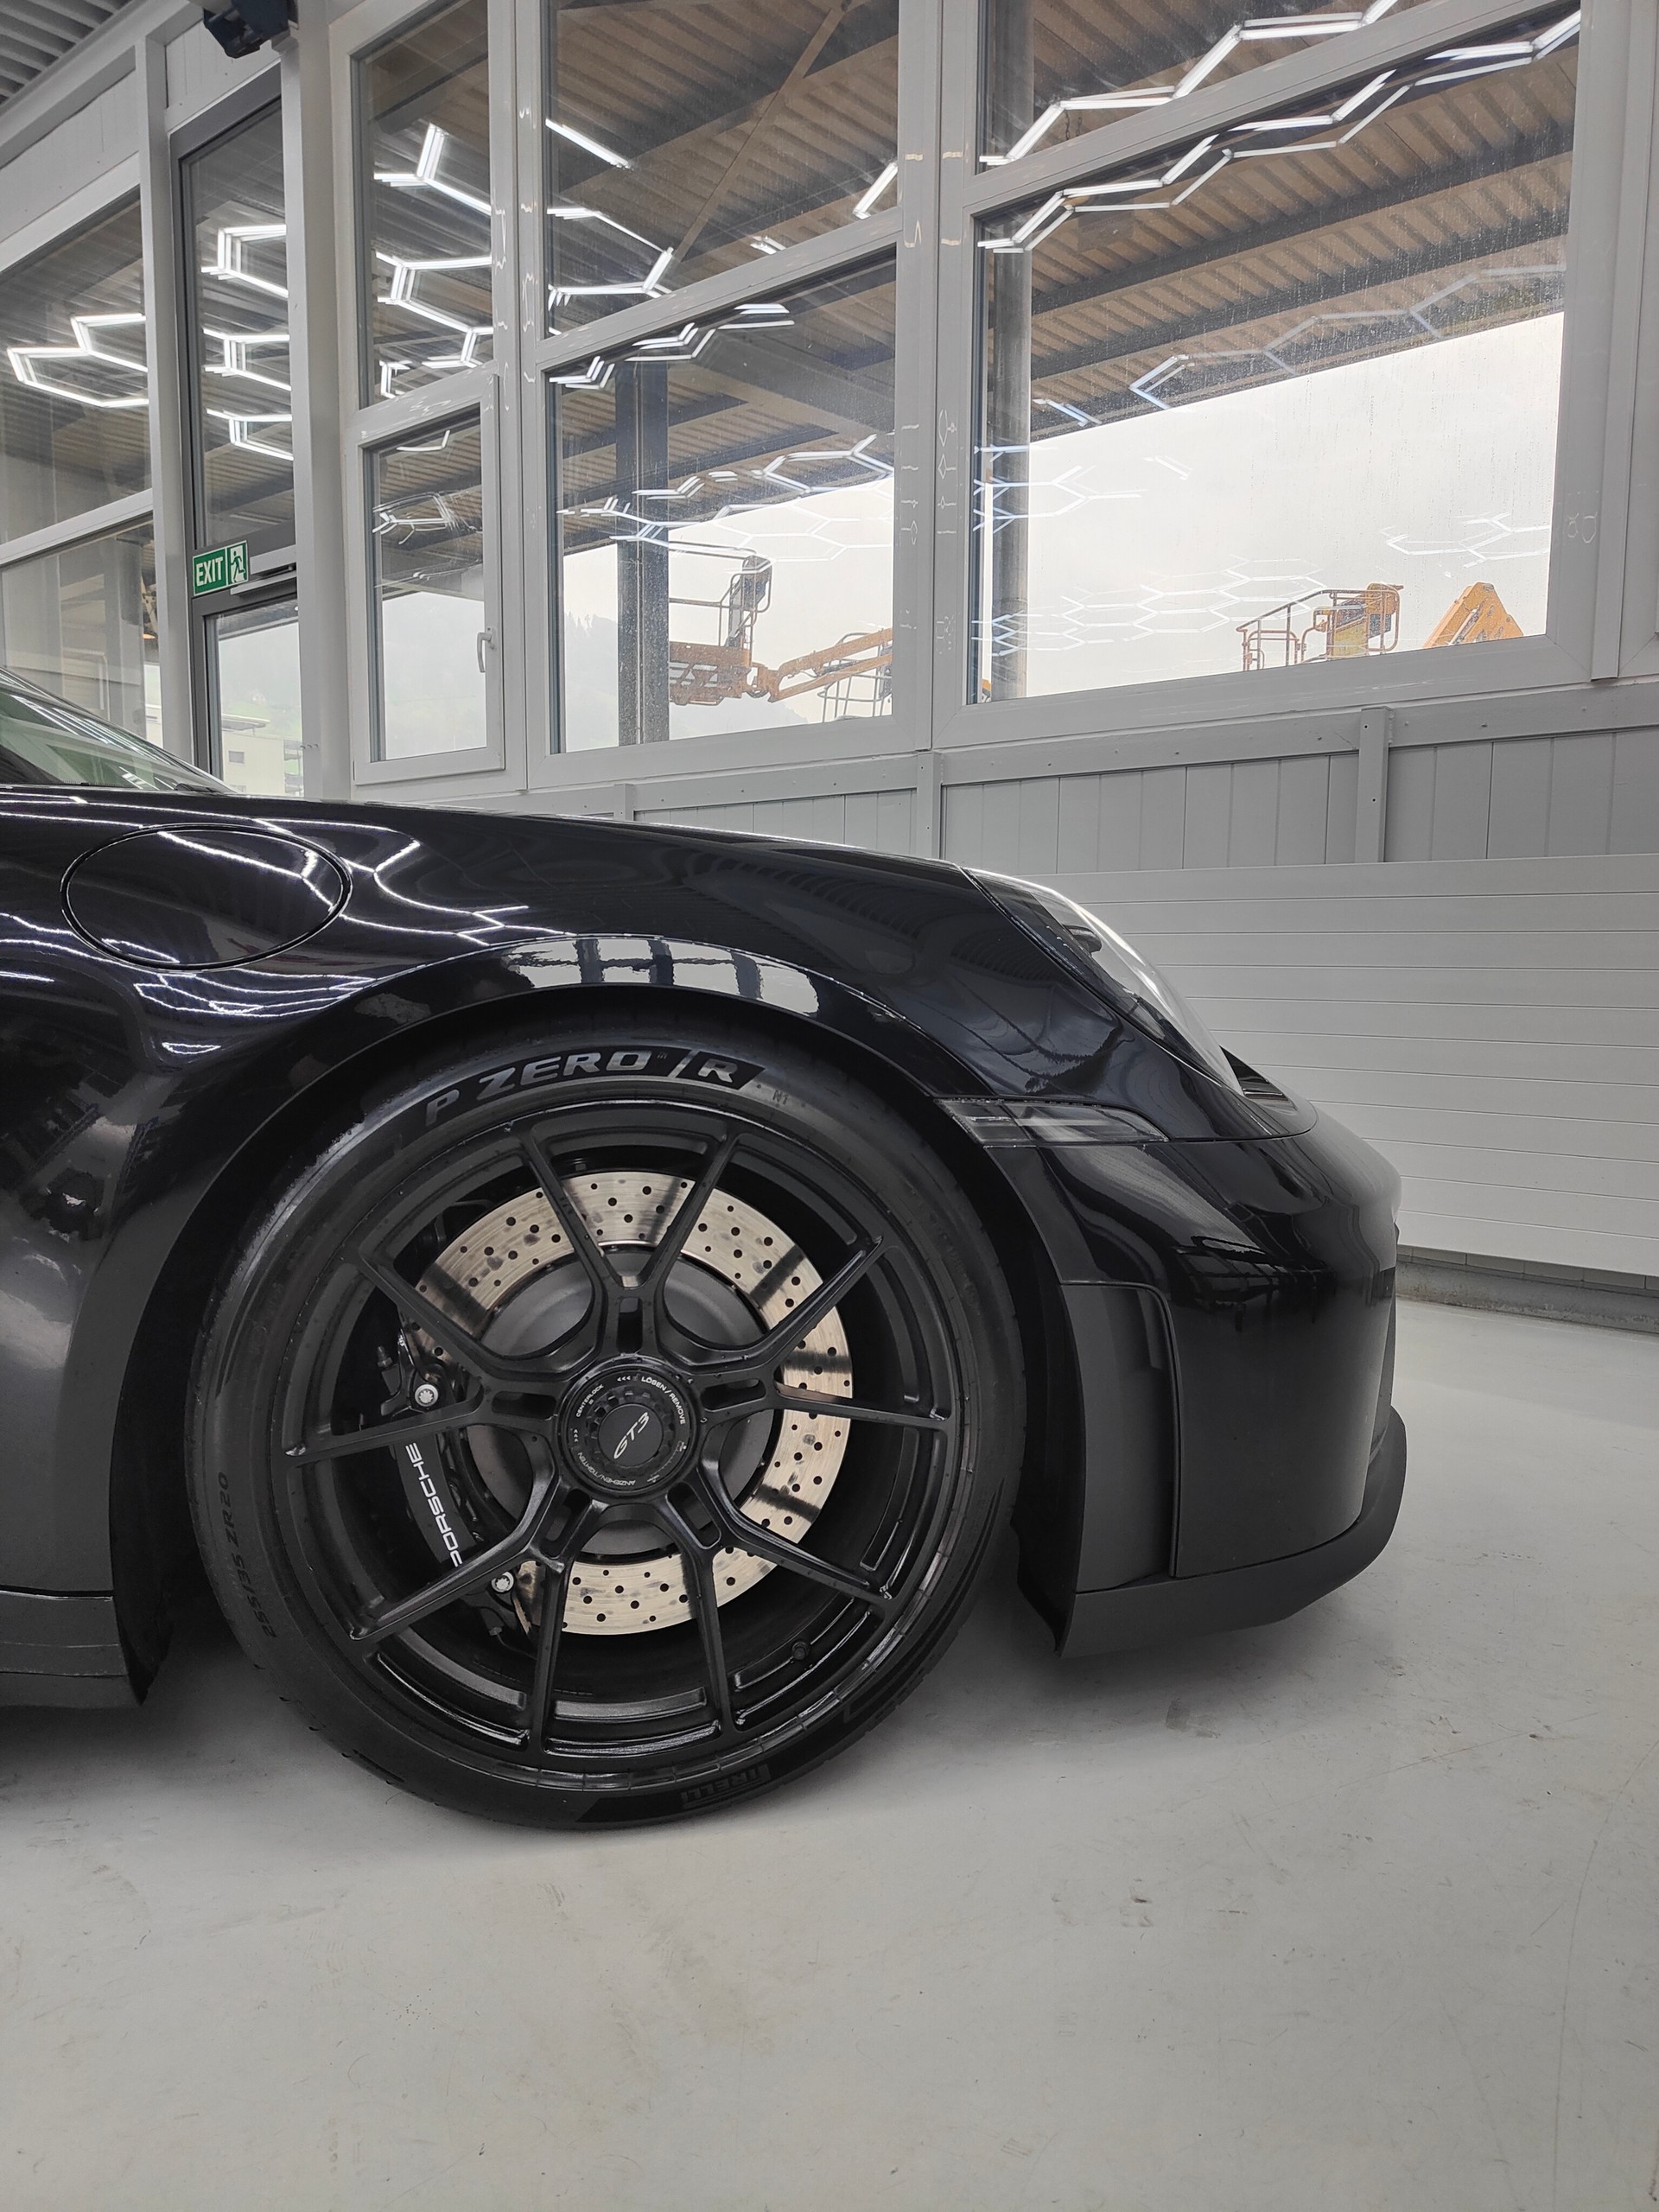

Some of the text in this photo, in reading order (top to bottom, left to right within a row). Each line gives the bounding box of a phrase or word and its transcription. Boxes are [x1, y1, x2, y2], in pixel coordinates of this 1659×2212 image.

[196, 556, 224, 587] EXIT
[424, 1050, 738, 1126] P ZERO R
[575, 1383, 604, 1418] CENTERLOCK
[613, 1411, 650, 1459] GT3
[218, 1471, 277, 1638] 255/35 ZR20
[680, 1764, 772, 1810] PIRELLI
